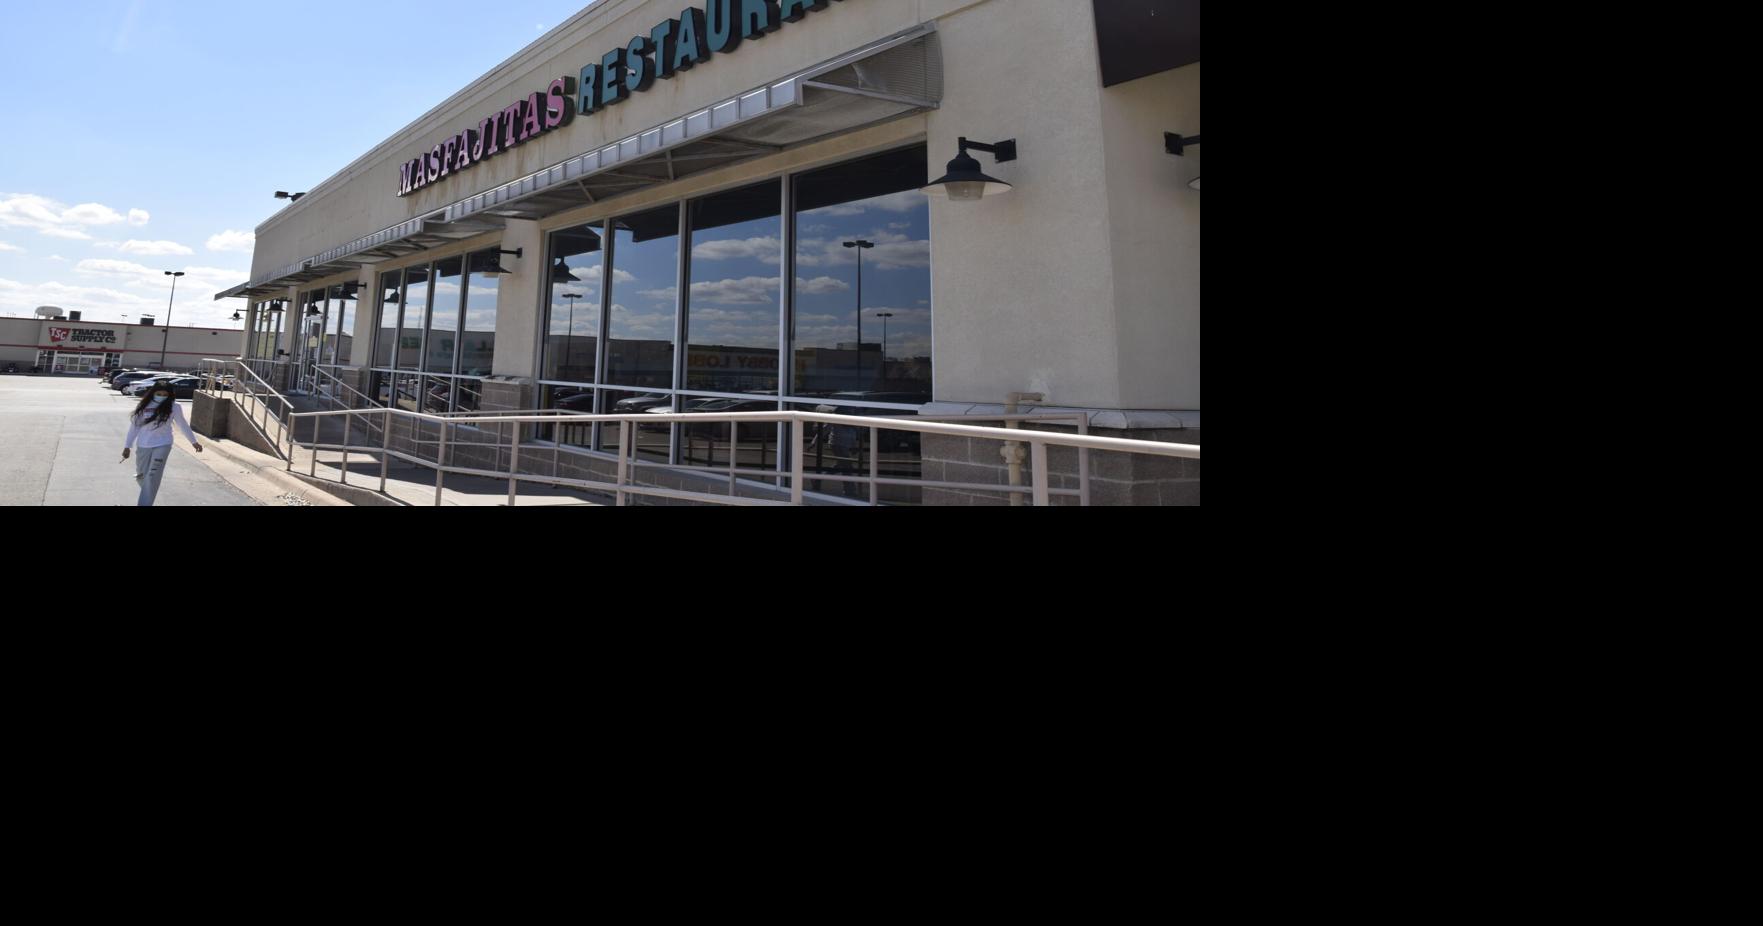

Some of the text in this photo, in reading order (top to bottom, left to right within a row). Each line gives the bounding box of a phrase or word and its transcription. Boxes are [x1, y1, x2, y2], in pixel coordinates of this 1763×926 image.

[397, 77, 567, 197] MASFAJITAS
[50, 328, 67, 340] TSC
[70, 335, 105, 343] SUPPLY
